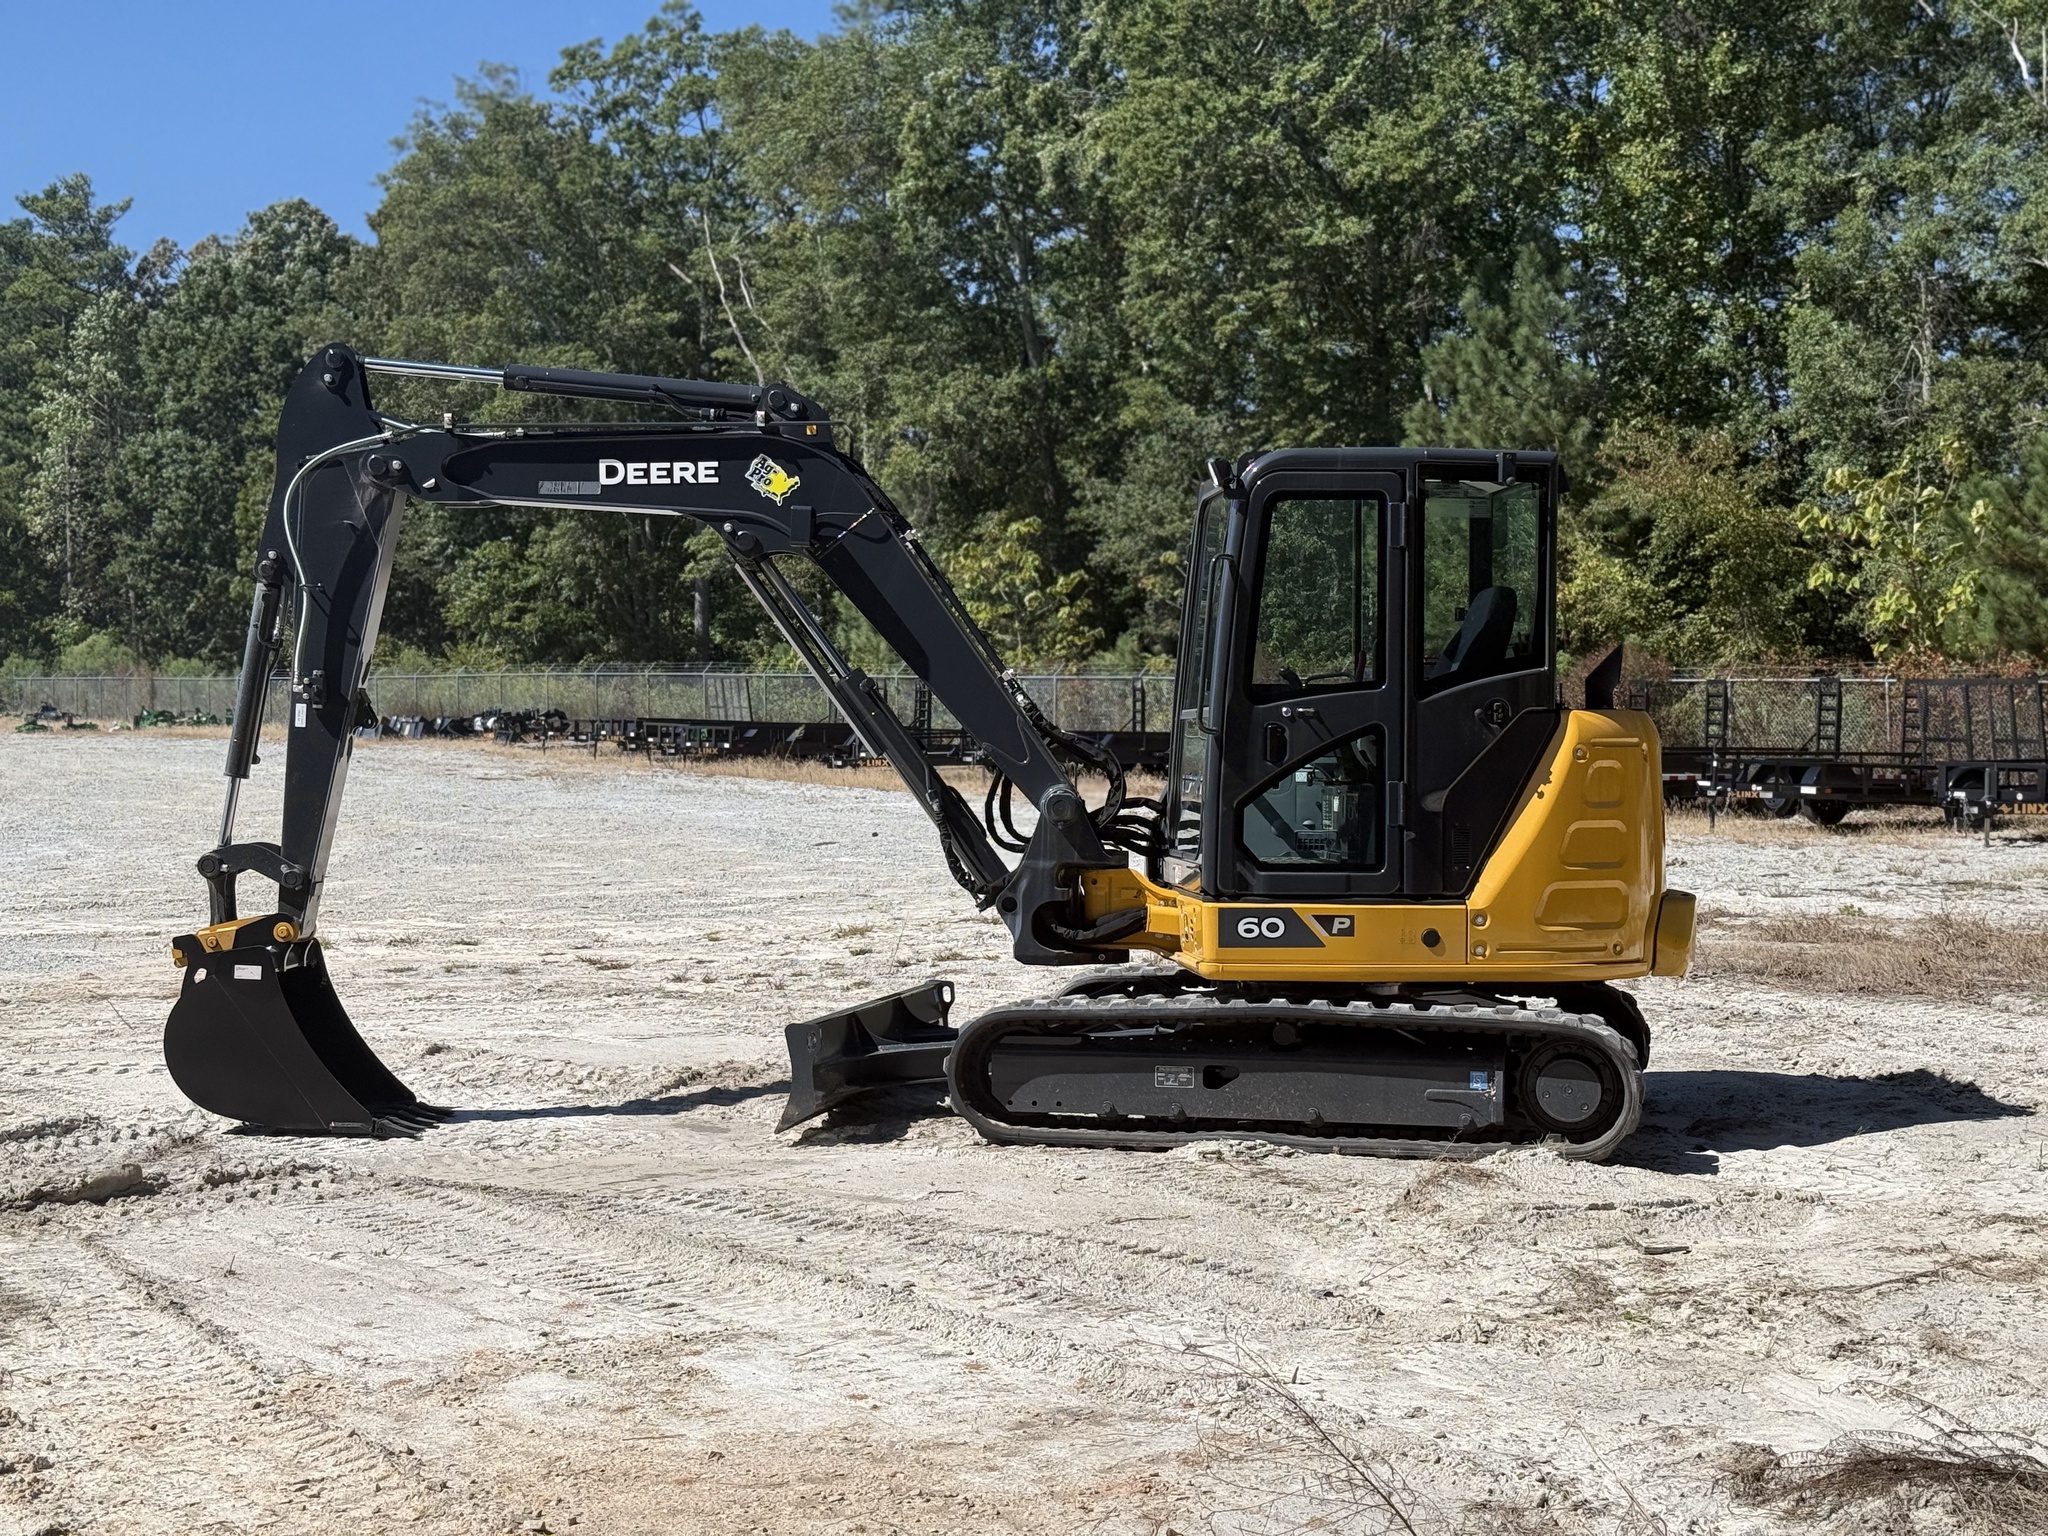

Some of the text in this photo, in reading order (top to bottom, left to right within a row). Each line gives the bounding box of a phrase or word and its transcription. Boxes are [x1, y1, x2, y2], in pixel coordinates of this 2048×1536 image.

[598, 458, 719, 486] DEERE
[749, 467, 772, 486] Pro
[698, 747, 719, 755] LINX
[866, 759, 889, 767] LINX
[1736, 790, 1759, 799] LINX
[2013, 803, 2048, 814] LINX
[1237, 917, 1351, 939] 60 P
